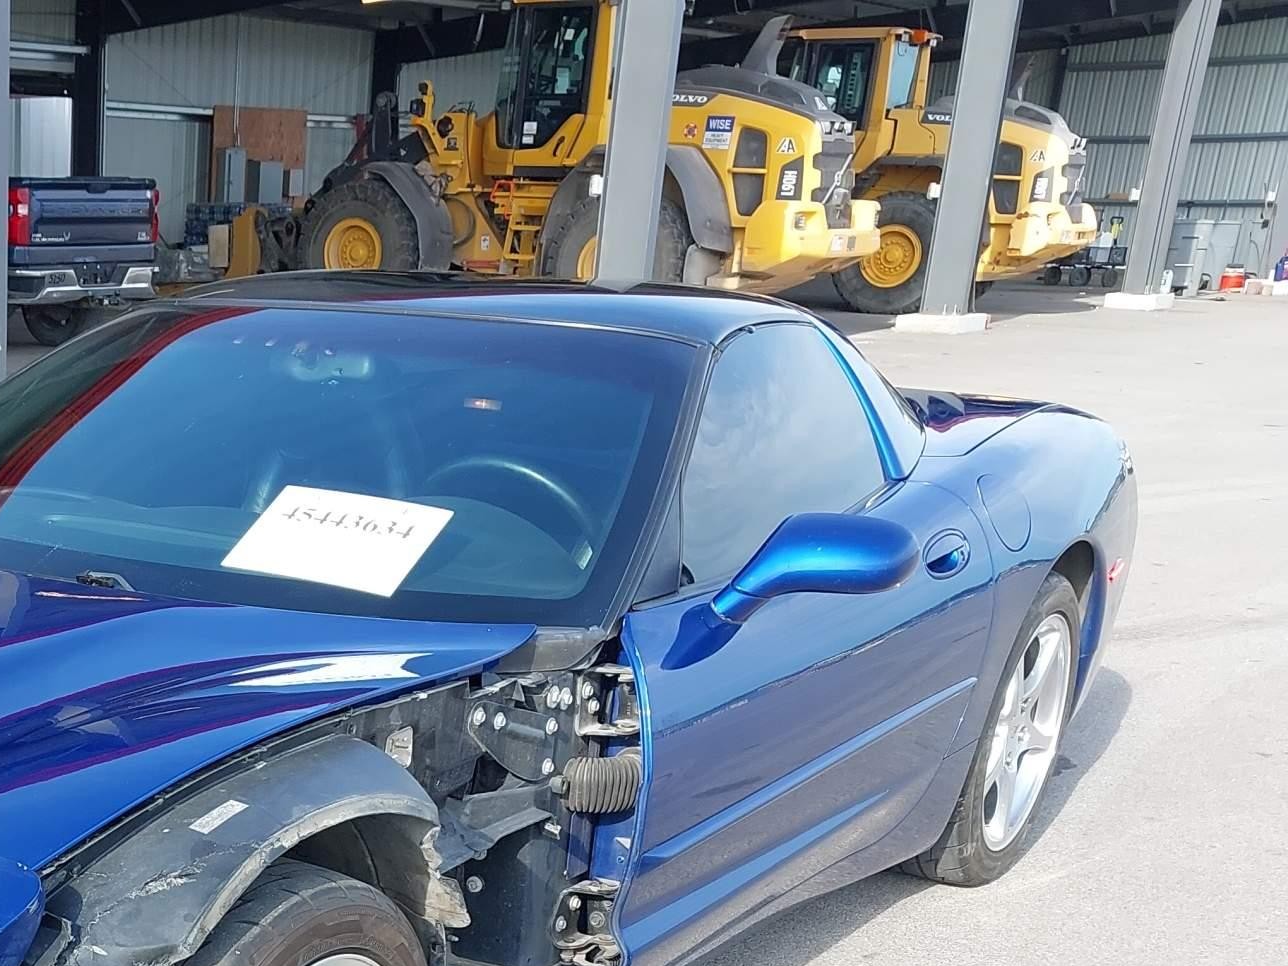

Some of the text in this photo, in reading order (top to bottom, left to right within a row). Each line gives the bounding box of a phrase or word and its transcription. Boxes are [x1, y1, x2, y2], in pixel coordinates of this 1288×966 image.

[671, 94, 708, 104] OLVO
[927, 114, 953, 122] VOL
[709, 119, 732, 130] WISE
[780, 170, 798, 197] L90H
